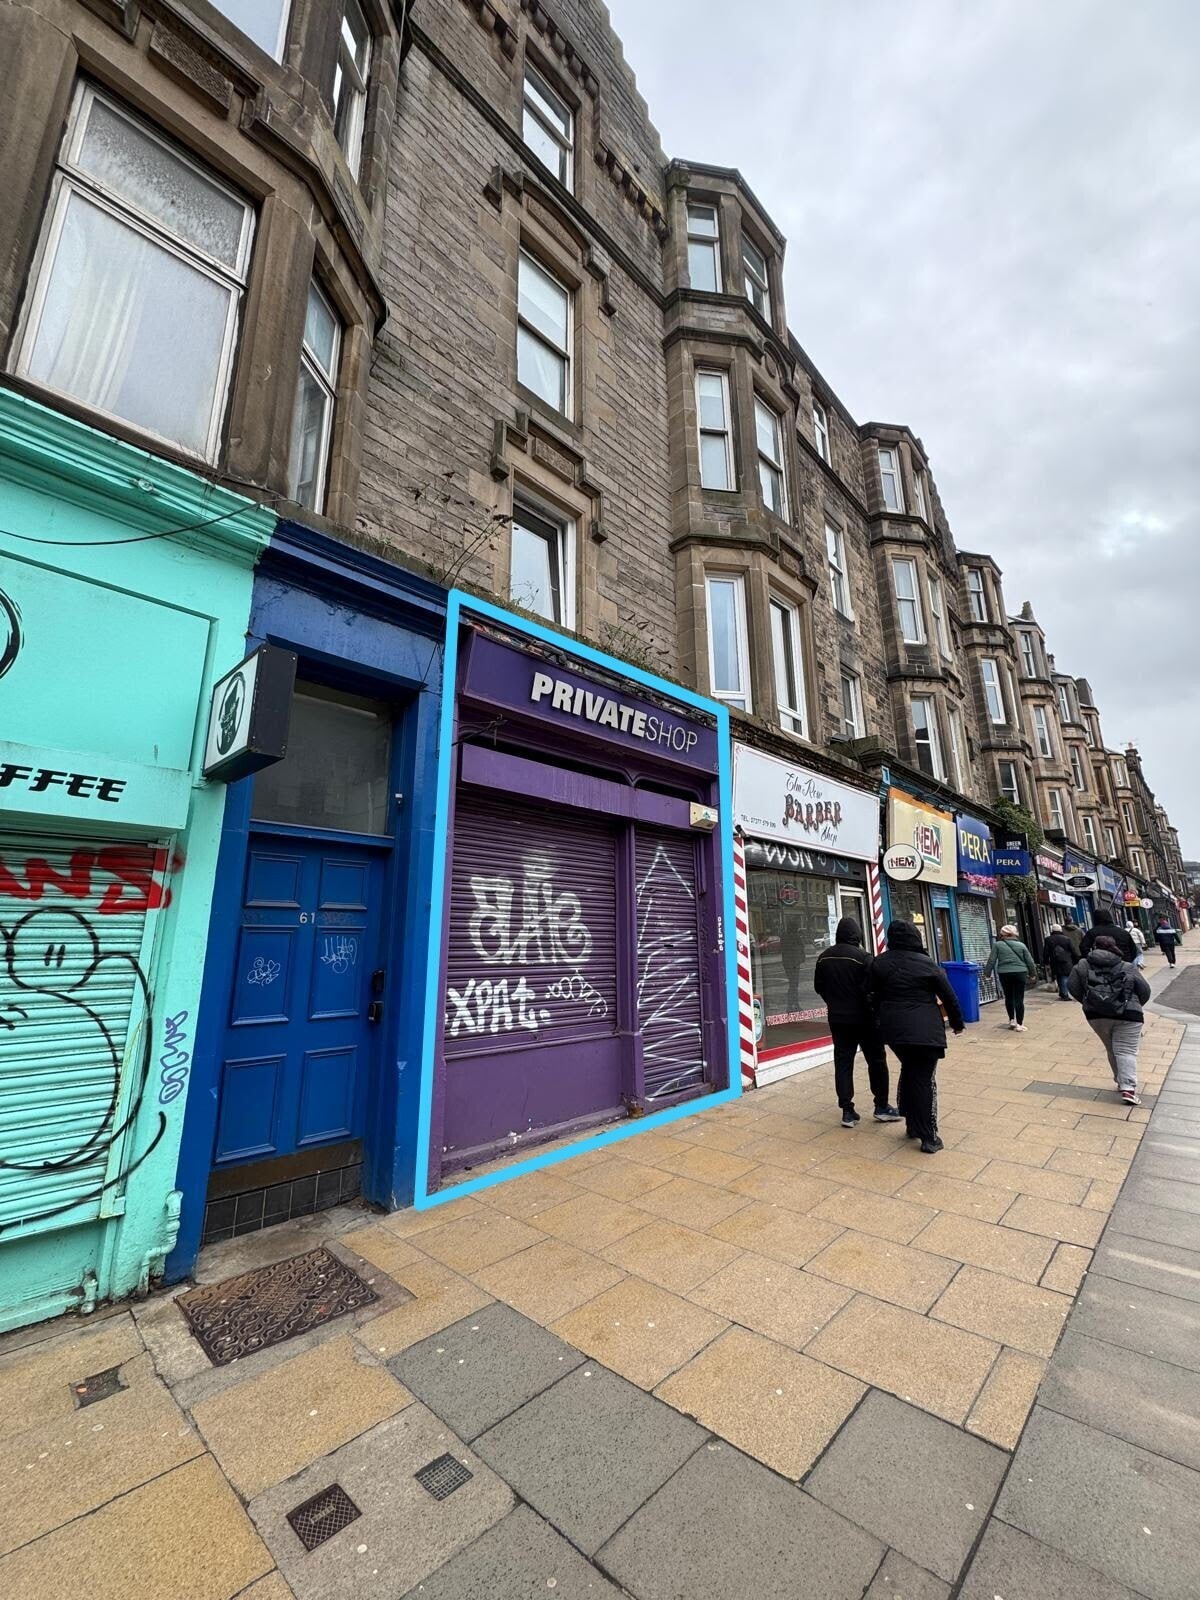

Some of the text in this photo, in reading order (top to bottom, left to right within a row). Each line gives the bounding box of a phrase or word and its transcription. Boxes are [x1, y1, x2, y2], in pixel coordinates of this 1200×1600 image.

[782, 794, 843, 832] BARBER
[916, 826, 940, 860] NEM
[960, 831, 991, 865] PERA
[890, 855, 915, 867] NEM
[996, 858, 1021, 866] PERA
[299, 912, 316, 924] 61
